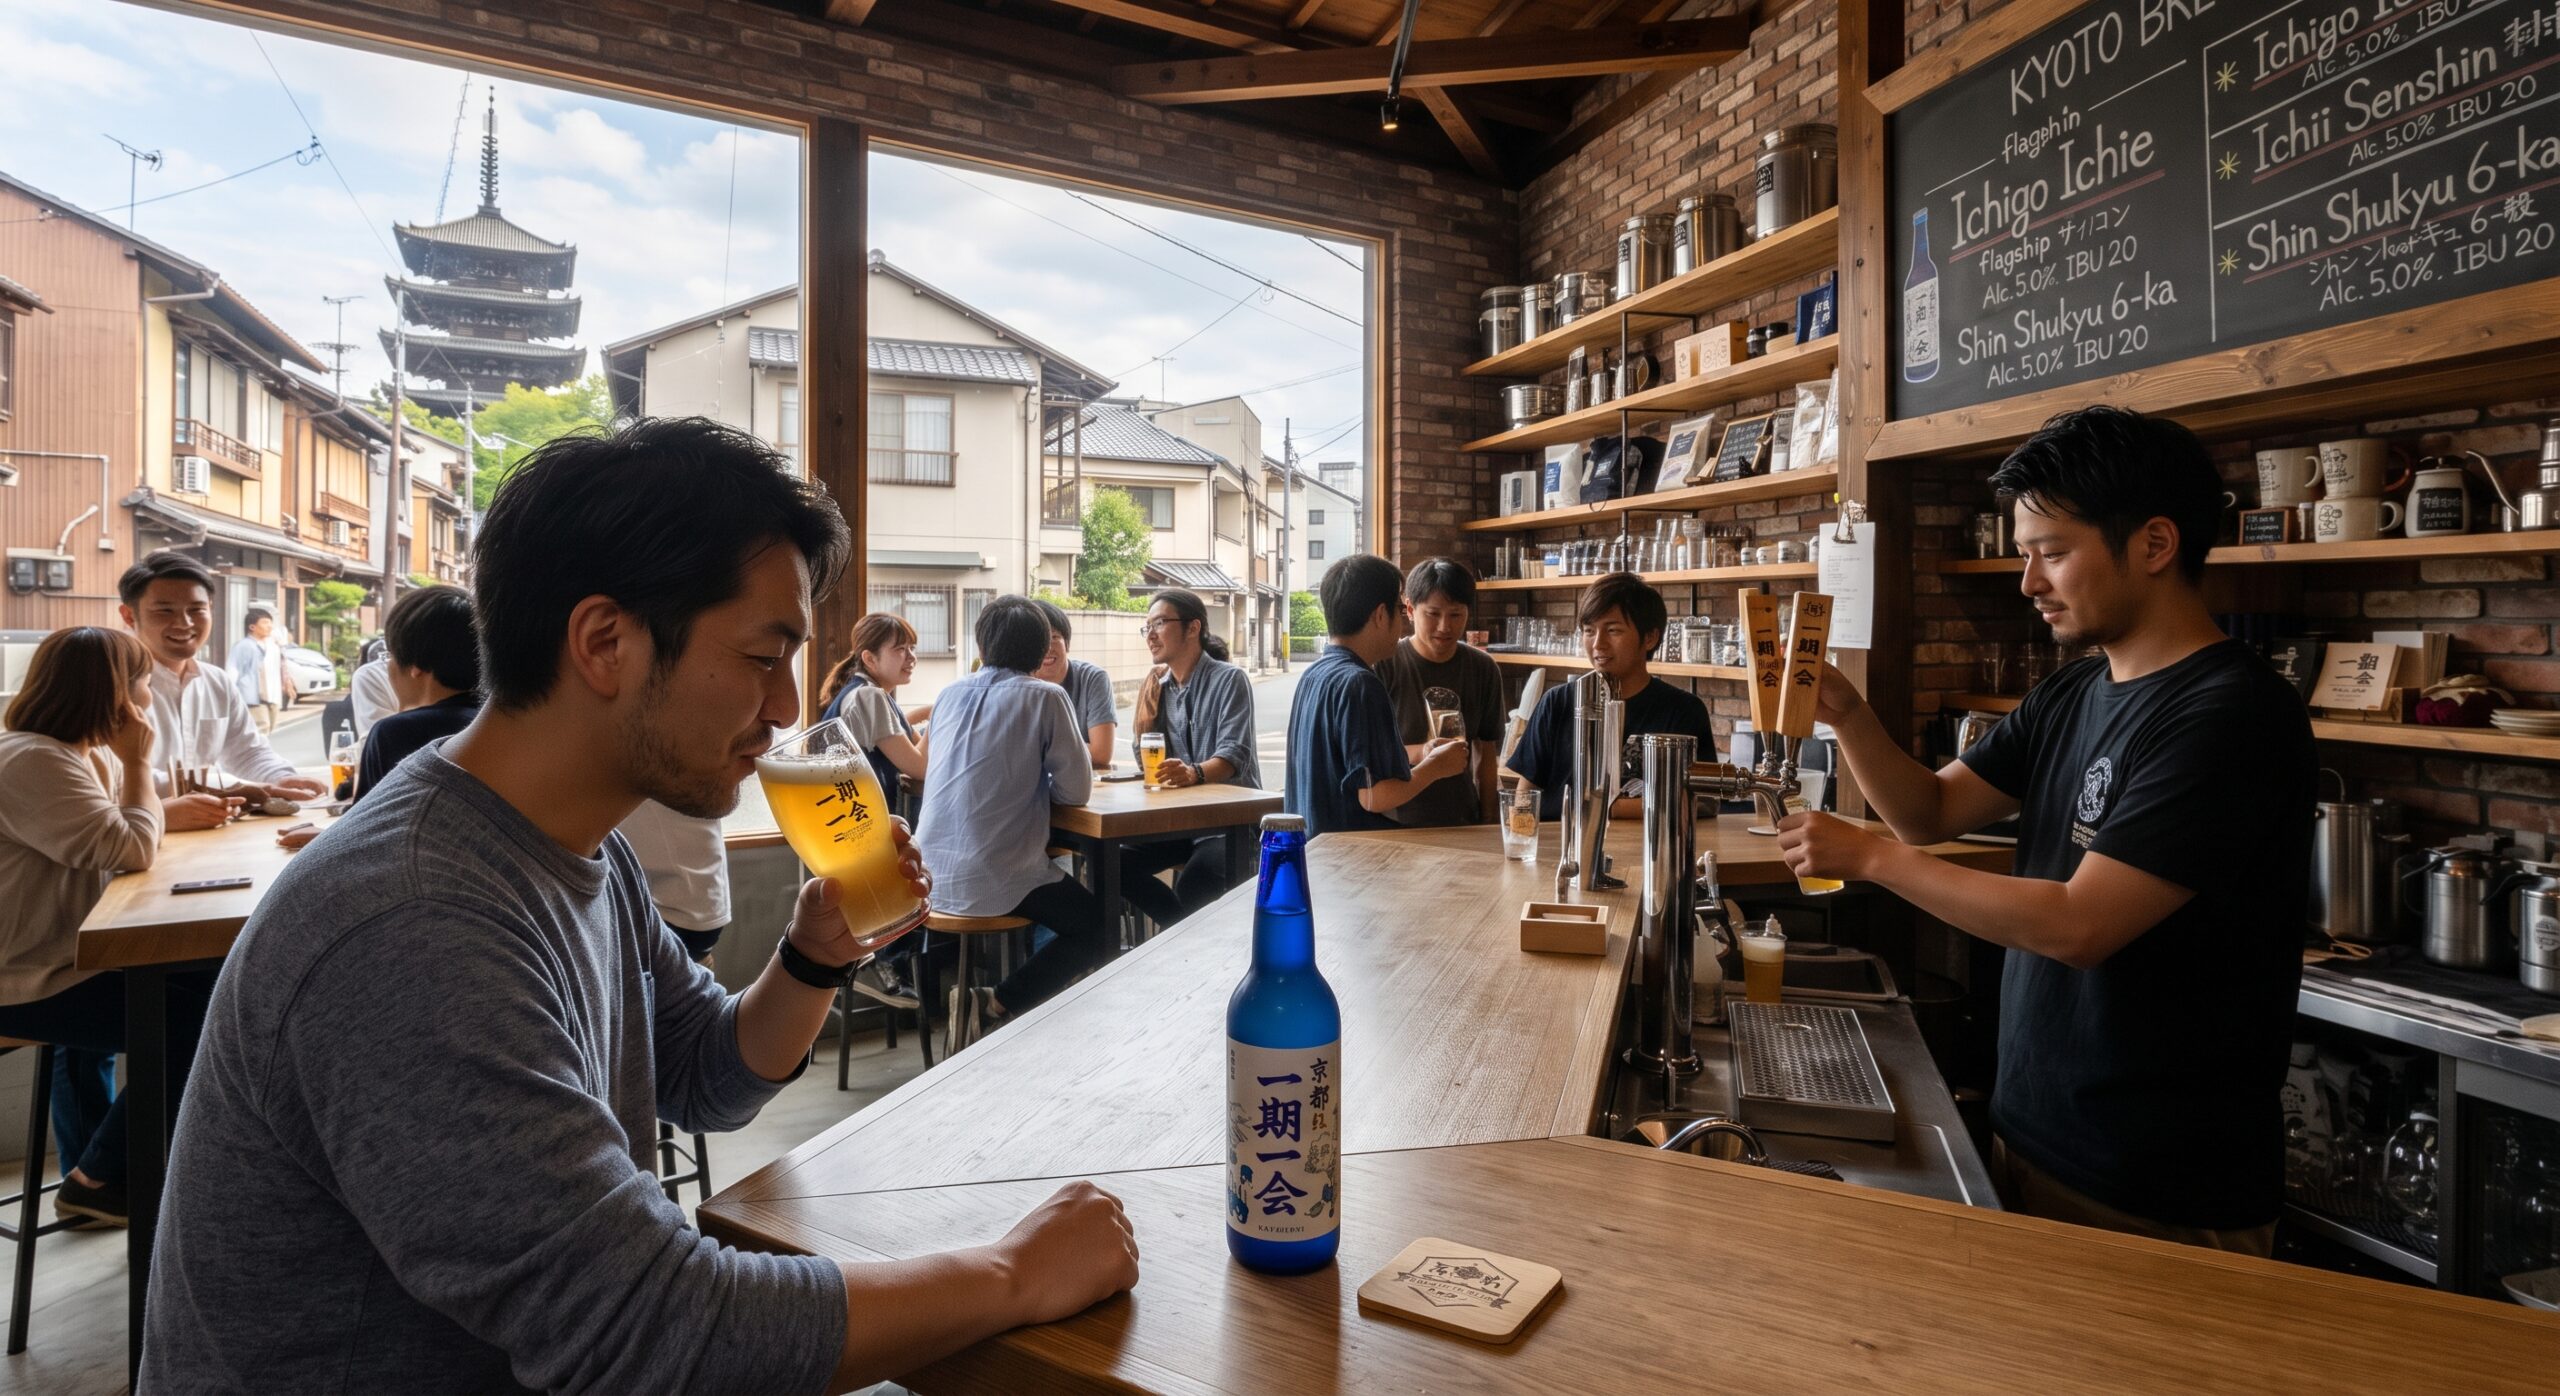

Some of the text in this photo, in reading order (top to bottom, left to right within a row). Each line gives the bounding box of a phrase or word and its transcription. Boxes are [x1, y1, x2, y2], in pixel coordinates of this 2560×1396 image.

[2010, 11, 2123, 117] KYOTO
[2253, 6, 2360, 82] Ichigo
[2252, 107, 2330, 173] Ichii
[2345, 46, 2497, 132] Senshin
[2446, 91, 2492, 128] IBU
[2500, 74, 2537, 108] 20
[1951, 124, 2155, 250] Ichigo Ichie
[2247, 124, 2560, 271] Shin Shukyu 6-ka
[1979, 236, 2051, 276] flagship
[2066, 245, 2104, 281] IBU
[2108, 235, 2138, 268] 20
[2319, 279, 2364, 312] Alc.
[2453, 234, 2507, 275] IBU
[2515, 222, 2555, 257] 20
[1957, 270, 2178, 365] Shin Shukyu 6-ka
[1986, 325, 2149, 389] Alc. 5.0% IBU 20
[825, 800, 869, 826] 一会
[1252, 1072, 1309, 1216] 一期一会
